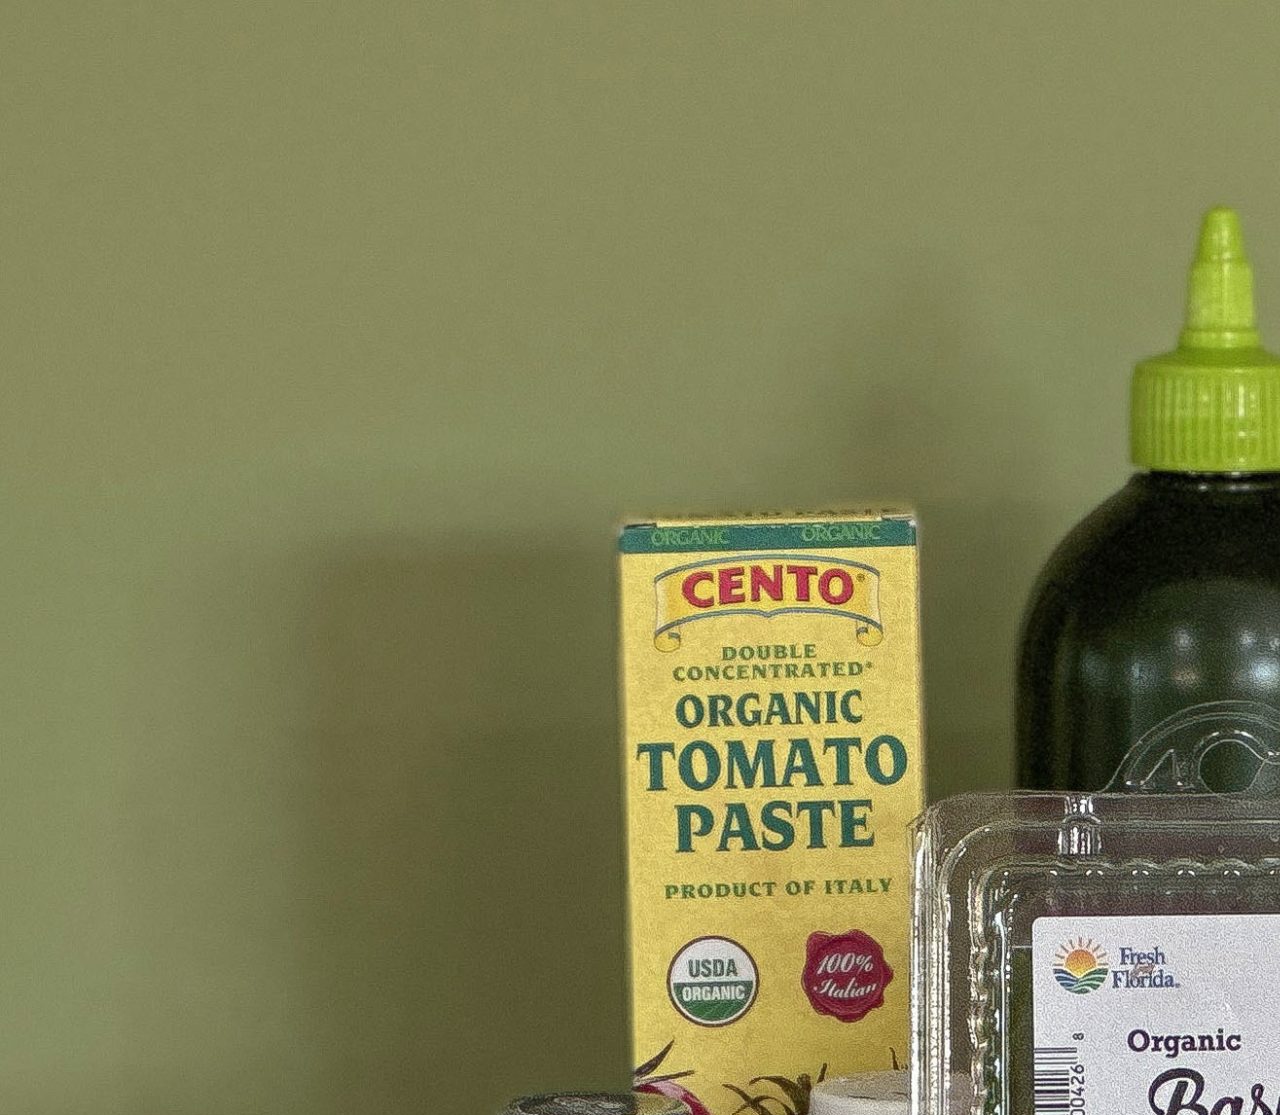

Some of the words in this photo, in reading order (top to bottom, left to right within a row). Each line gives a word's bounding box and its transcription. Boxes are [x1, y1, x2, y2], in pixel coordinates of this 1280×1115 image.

[650, 529, 731, 547] ORGANIC
[801, 524, 881, 542] ORGANIC
[681, 564, 855, 608] CENTO
[721, 644, 817, 661] DOUBLE
[675, 689, 864, 729] ORGANIC
[636, 735, 908, 792] TOMATO
[674, 798, 875, 853] PASTE
[664, 881, 778, 900] PRODUCT
[785, 880, 815, 897] OF
[824, 877, 893, 896] ITALY
[816, 952, 874, 975] 100%
[1119, 946, 1167, 965] Fresh
[688, 958, 738, 978] USDA
[682, 984, 746, 1002] ORGANIC
[813, 976, 878, 999] Italian
[1072, 1032, 1084, 1041] 8
[1127, 1028, 1242, 1058] Organic
